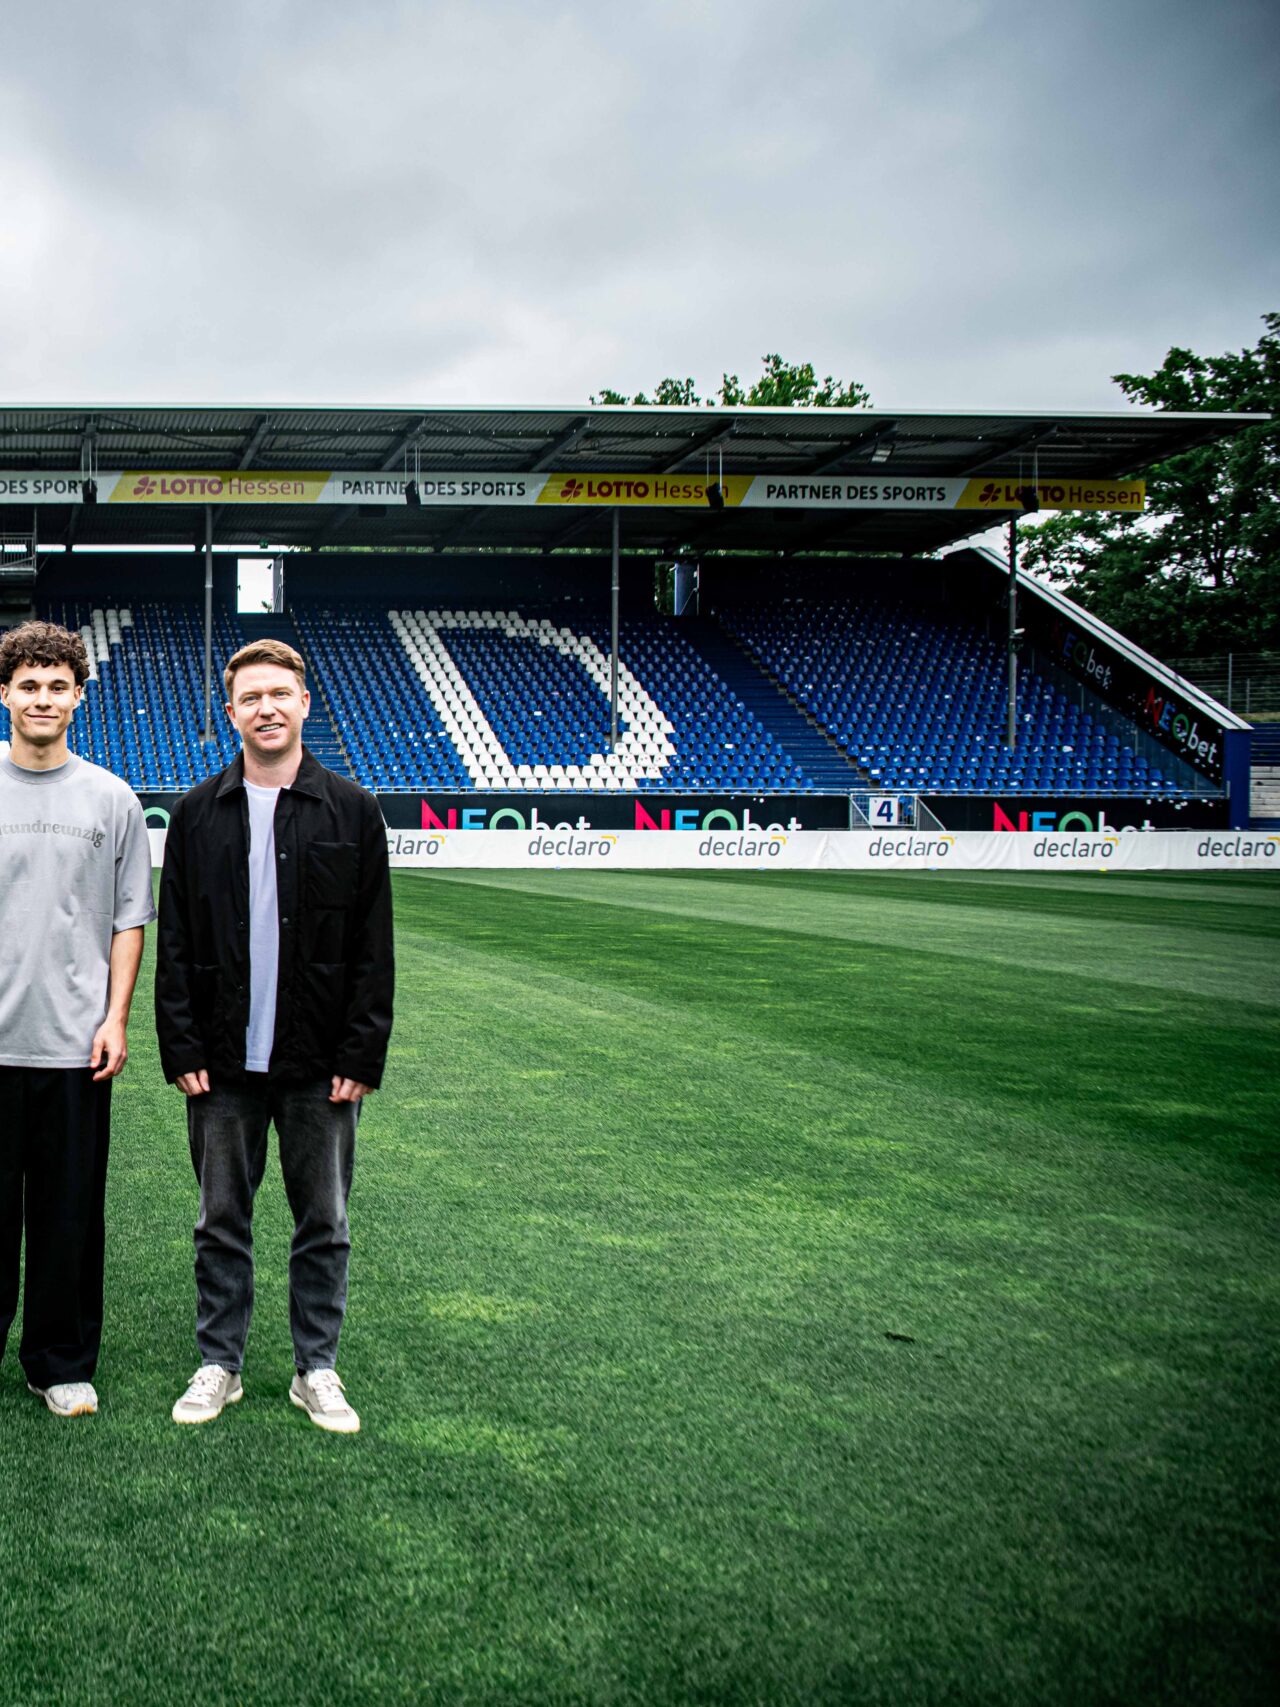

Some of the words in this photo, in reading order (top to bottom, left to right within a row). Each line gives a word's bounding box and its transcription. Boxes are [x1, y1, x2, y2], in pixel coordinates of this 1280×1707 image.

[161, 478, 223, 495] LOTTO
[229, 478, 305, 495] Hessen
[342, 480, 407, 495] PARTNE
[424, 481, 457, 496] DES
[461, 481, 526, 496] SPORTS
[587, 481, 649, 498] LOTTO
[655, 481, 729, 498] Hessn
[767, 485, 842, 499] PARTNER
[847, 486, 878, 500] DES
[883, 486, 946, 501] SPORTS
[1070, 487, 1141, 504] Hessen
[876, 800, 894, 822] 4
[527, 835, 612, 856] declaro
[698, 836, 782, 857] declaro
[868, 837, 950, 857] declaro
[1033, 837, 1114, 858] declaro
[1197, 837, 1276, 857] declaro
